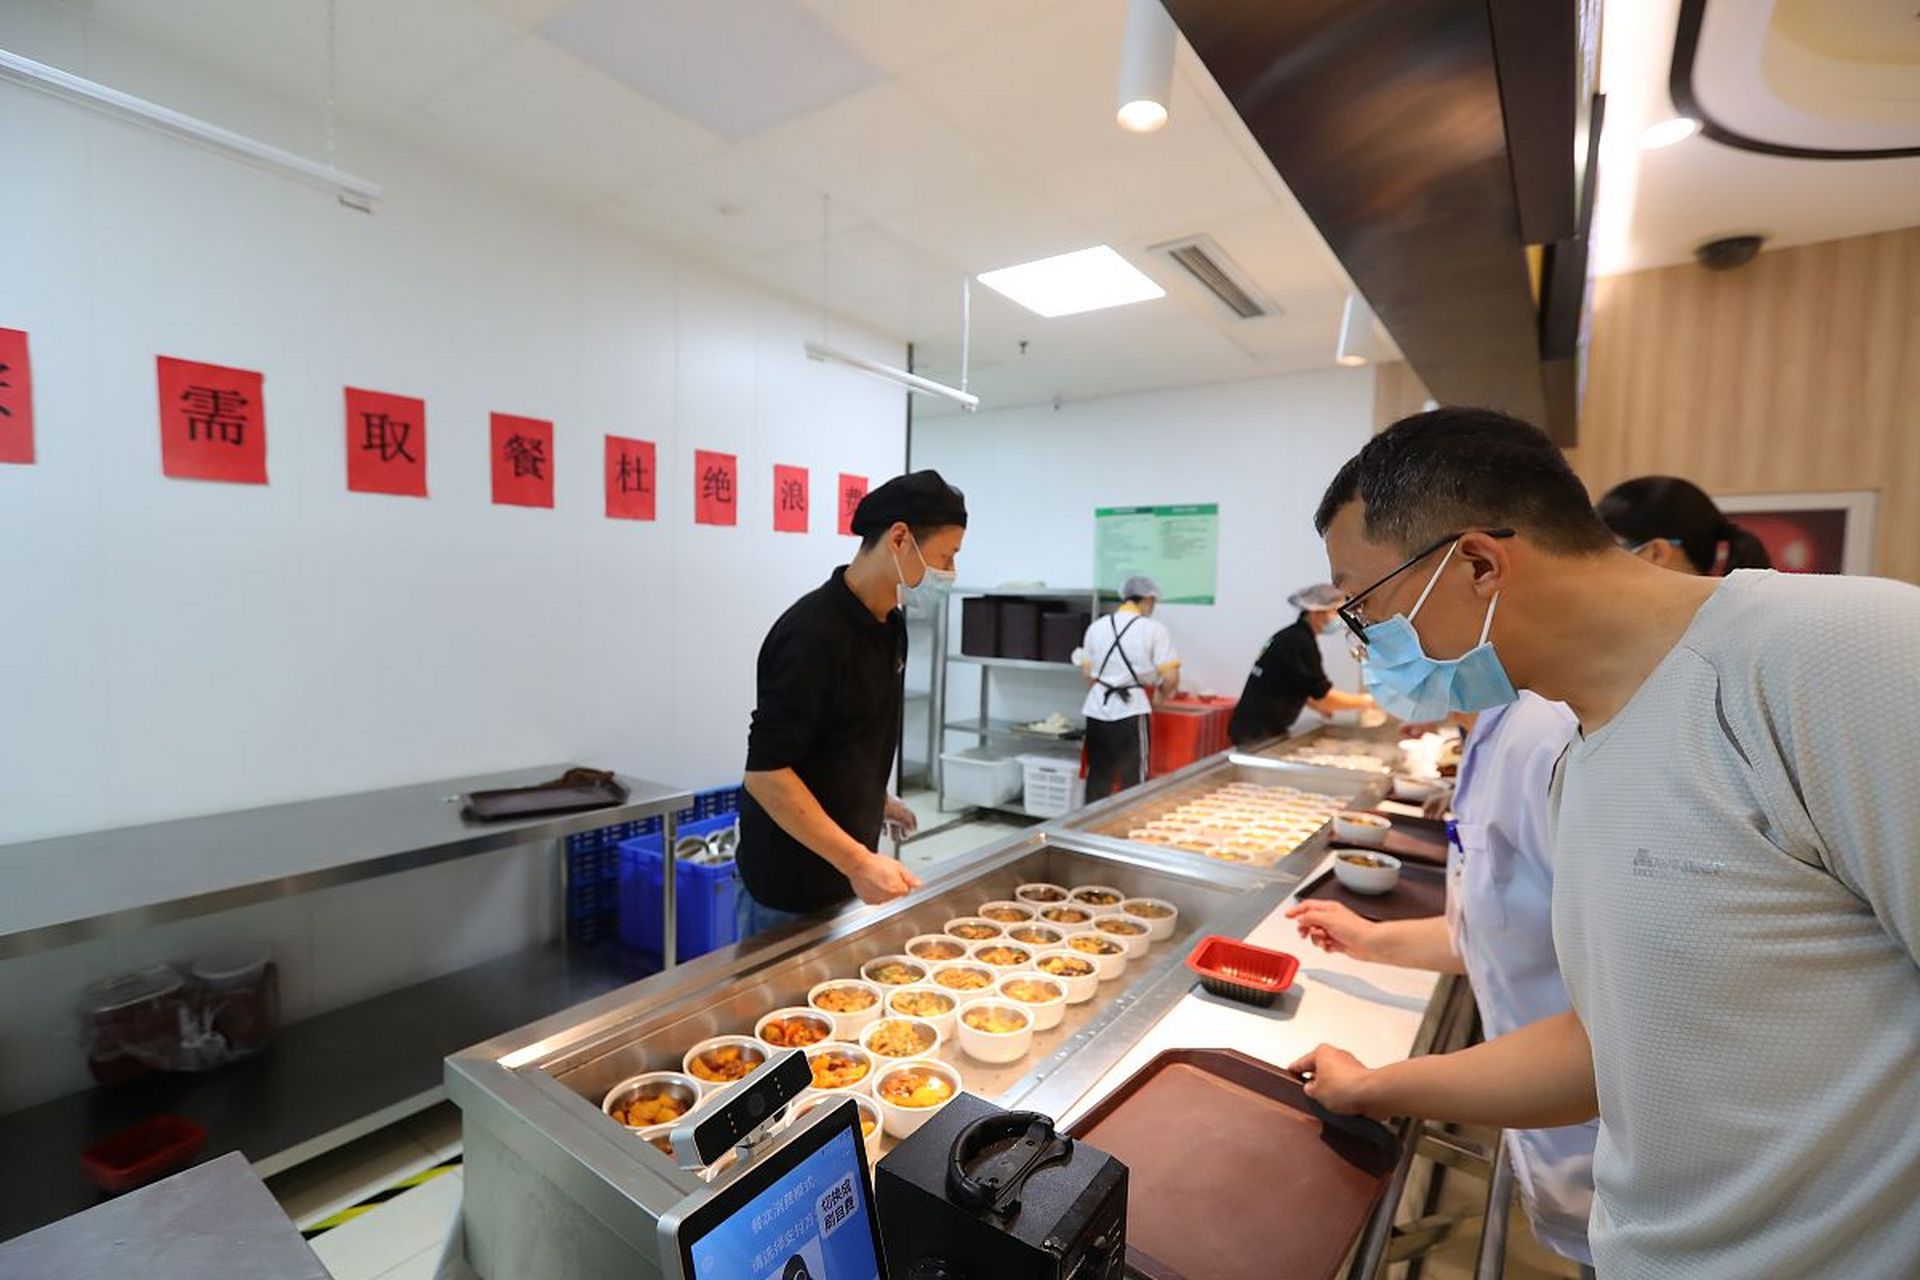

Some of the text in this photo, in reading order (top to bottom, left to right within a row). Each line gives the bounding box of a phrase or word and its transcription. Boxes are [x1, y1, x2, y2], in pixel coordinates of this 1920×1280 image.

[179, 385, 248, 446] 需
[360, 412, 417, 464] 取
[503, 433, 547, 481] 餐
[615, 452, 650, 494] 杜
[703, 465, 732, 503] 绝
[780, 479, 805, 512] 浪
